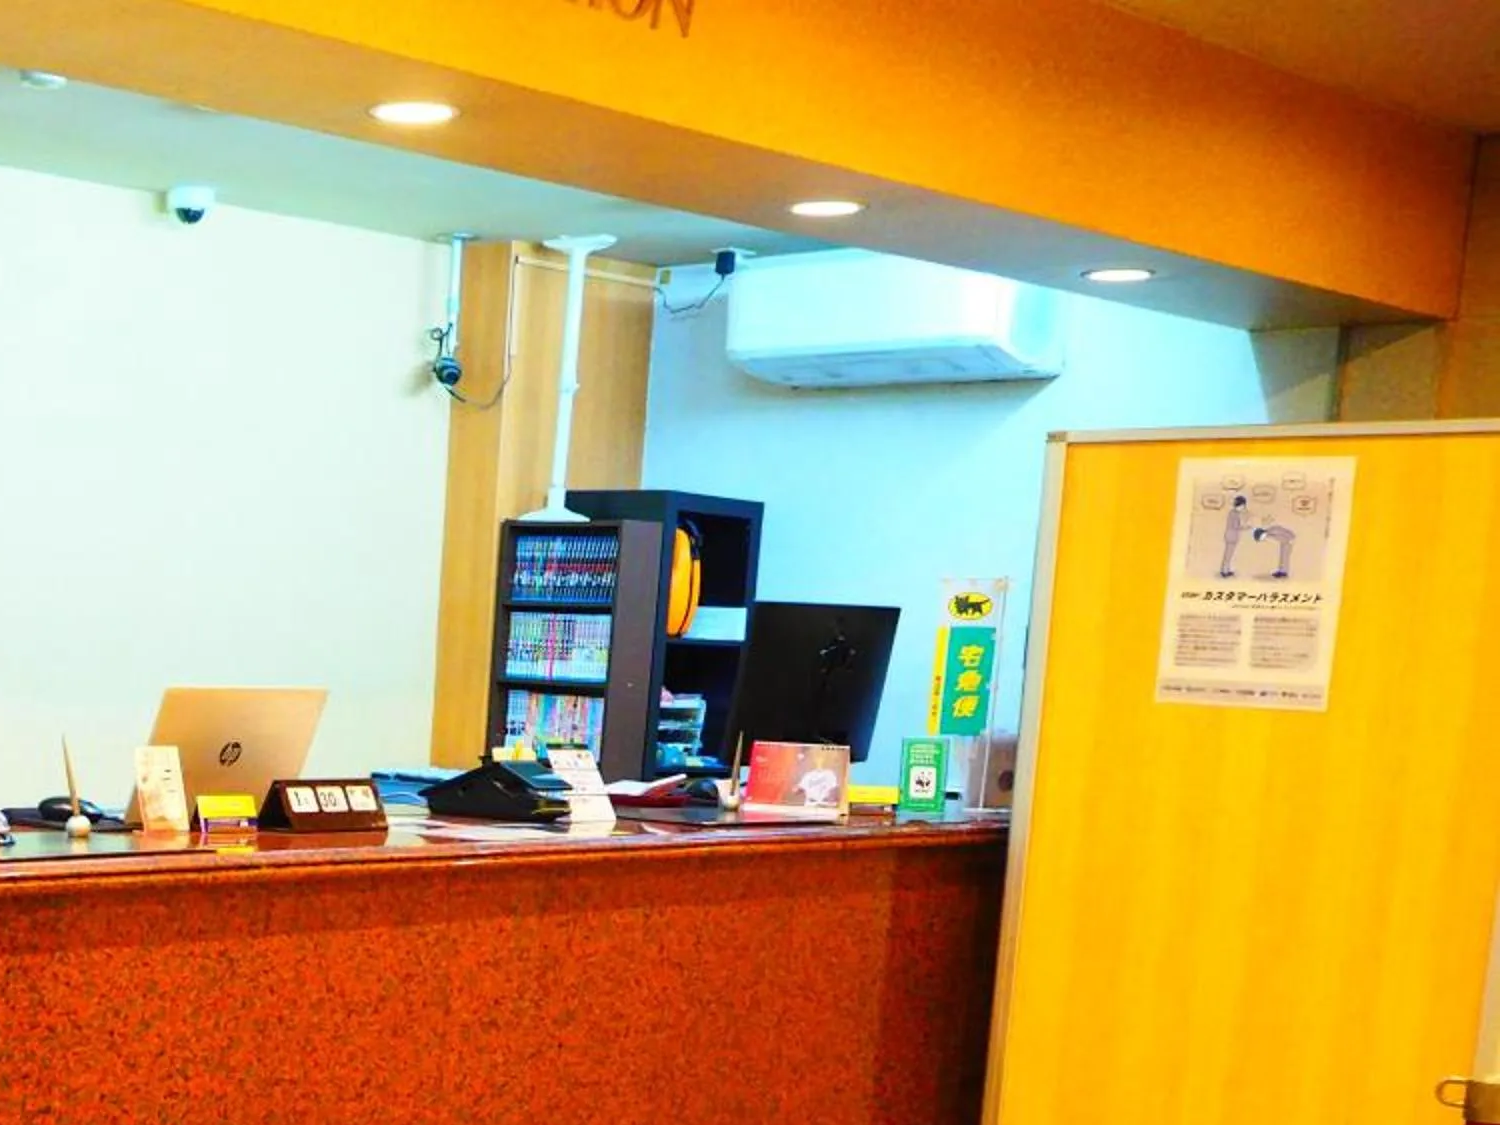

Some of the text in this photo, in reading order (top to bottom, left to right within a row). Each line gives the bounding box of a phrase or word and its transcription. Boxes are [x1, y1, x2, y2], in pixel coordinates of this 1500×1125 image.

[1202, 591, 1323, 604] カスタマーハラスメント
